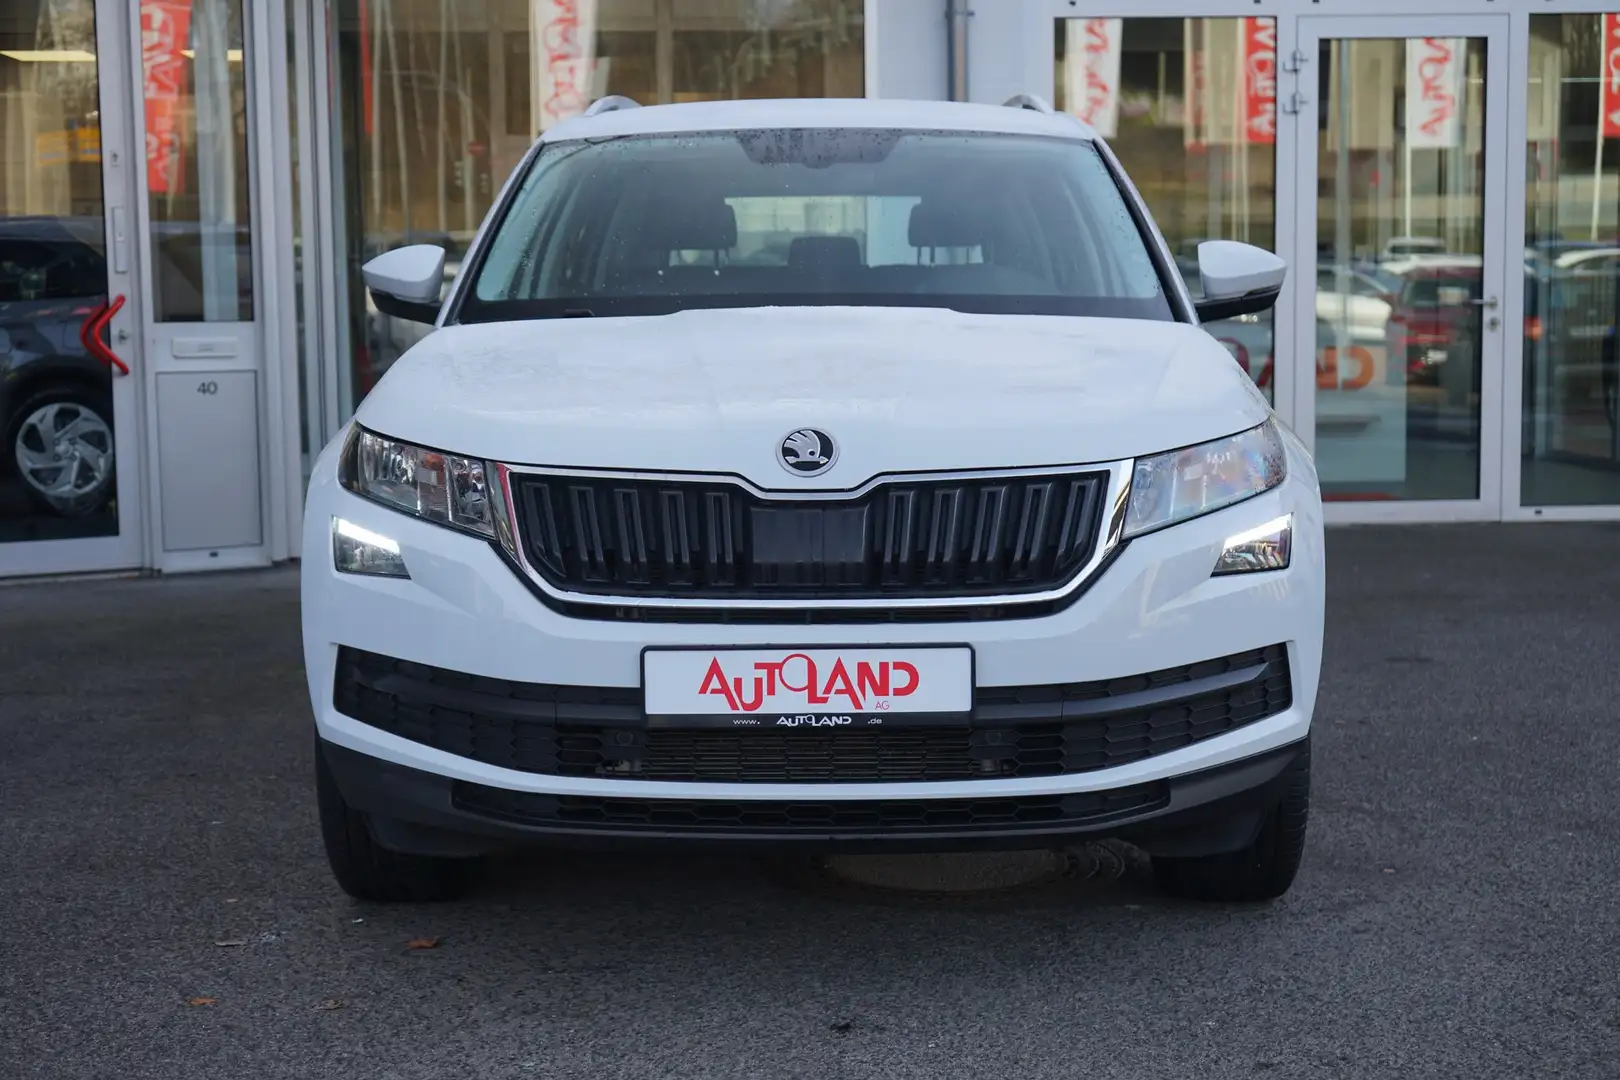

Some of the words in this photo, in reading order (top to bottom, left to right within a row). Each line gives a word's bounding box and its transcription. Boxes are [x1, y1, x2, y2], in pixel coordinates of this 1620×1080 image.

[197, 380, 219, 396] 40
[698, 653, 920, 712] AUTOLAND
[875, 700, 890, 711] AG
[775, 714, 852, 727] AUTOLAND
[868, 717, 883, 725] .de
